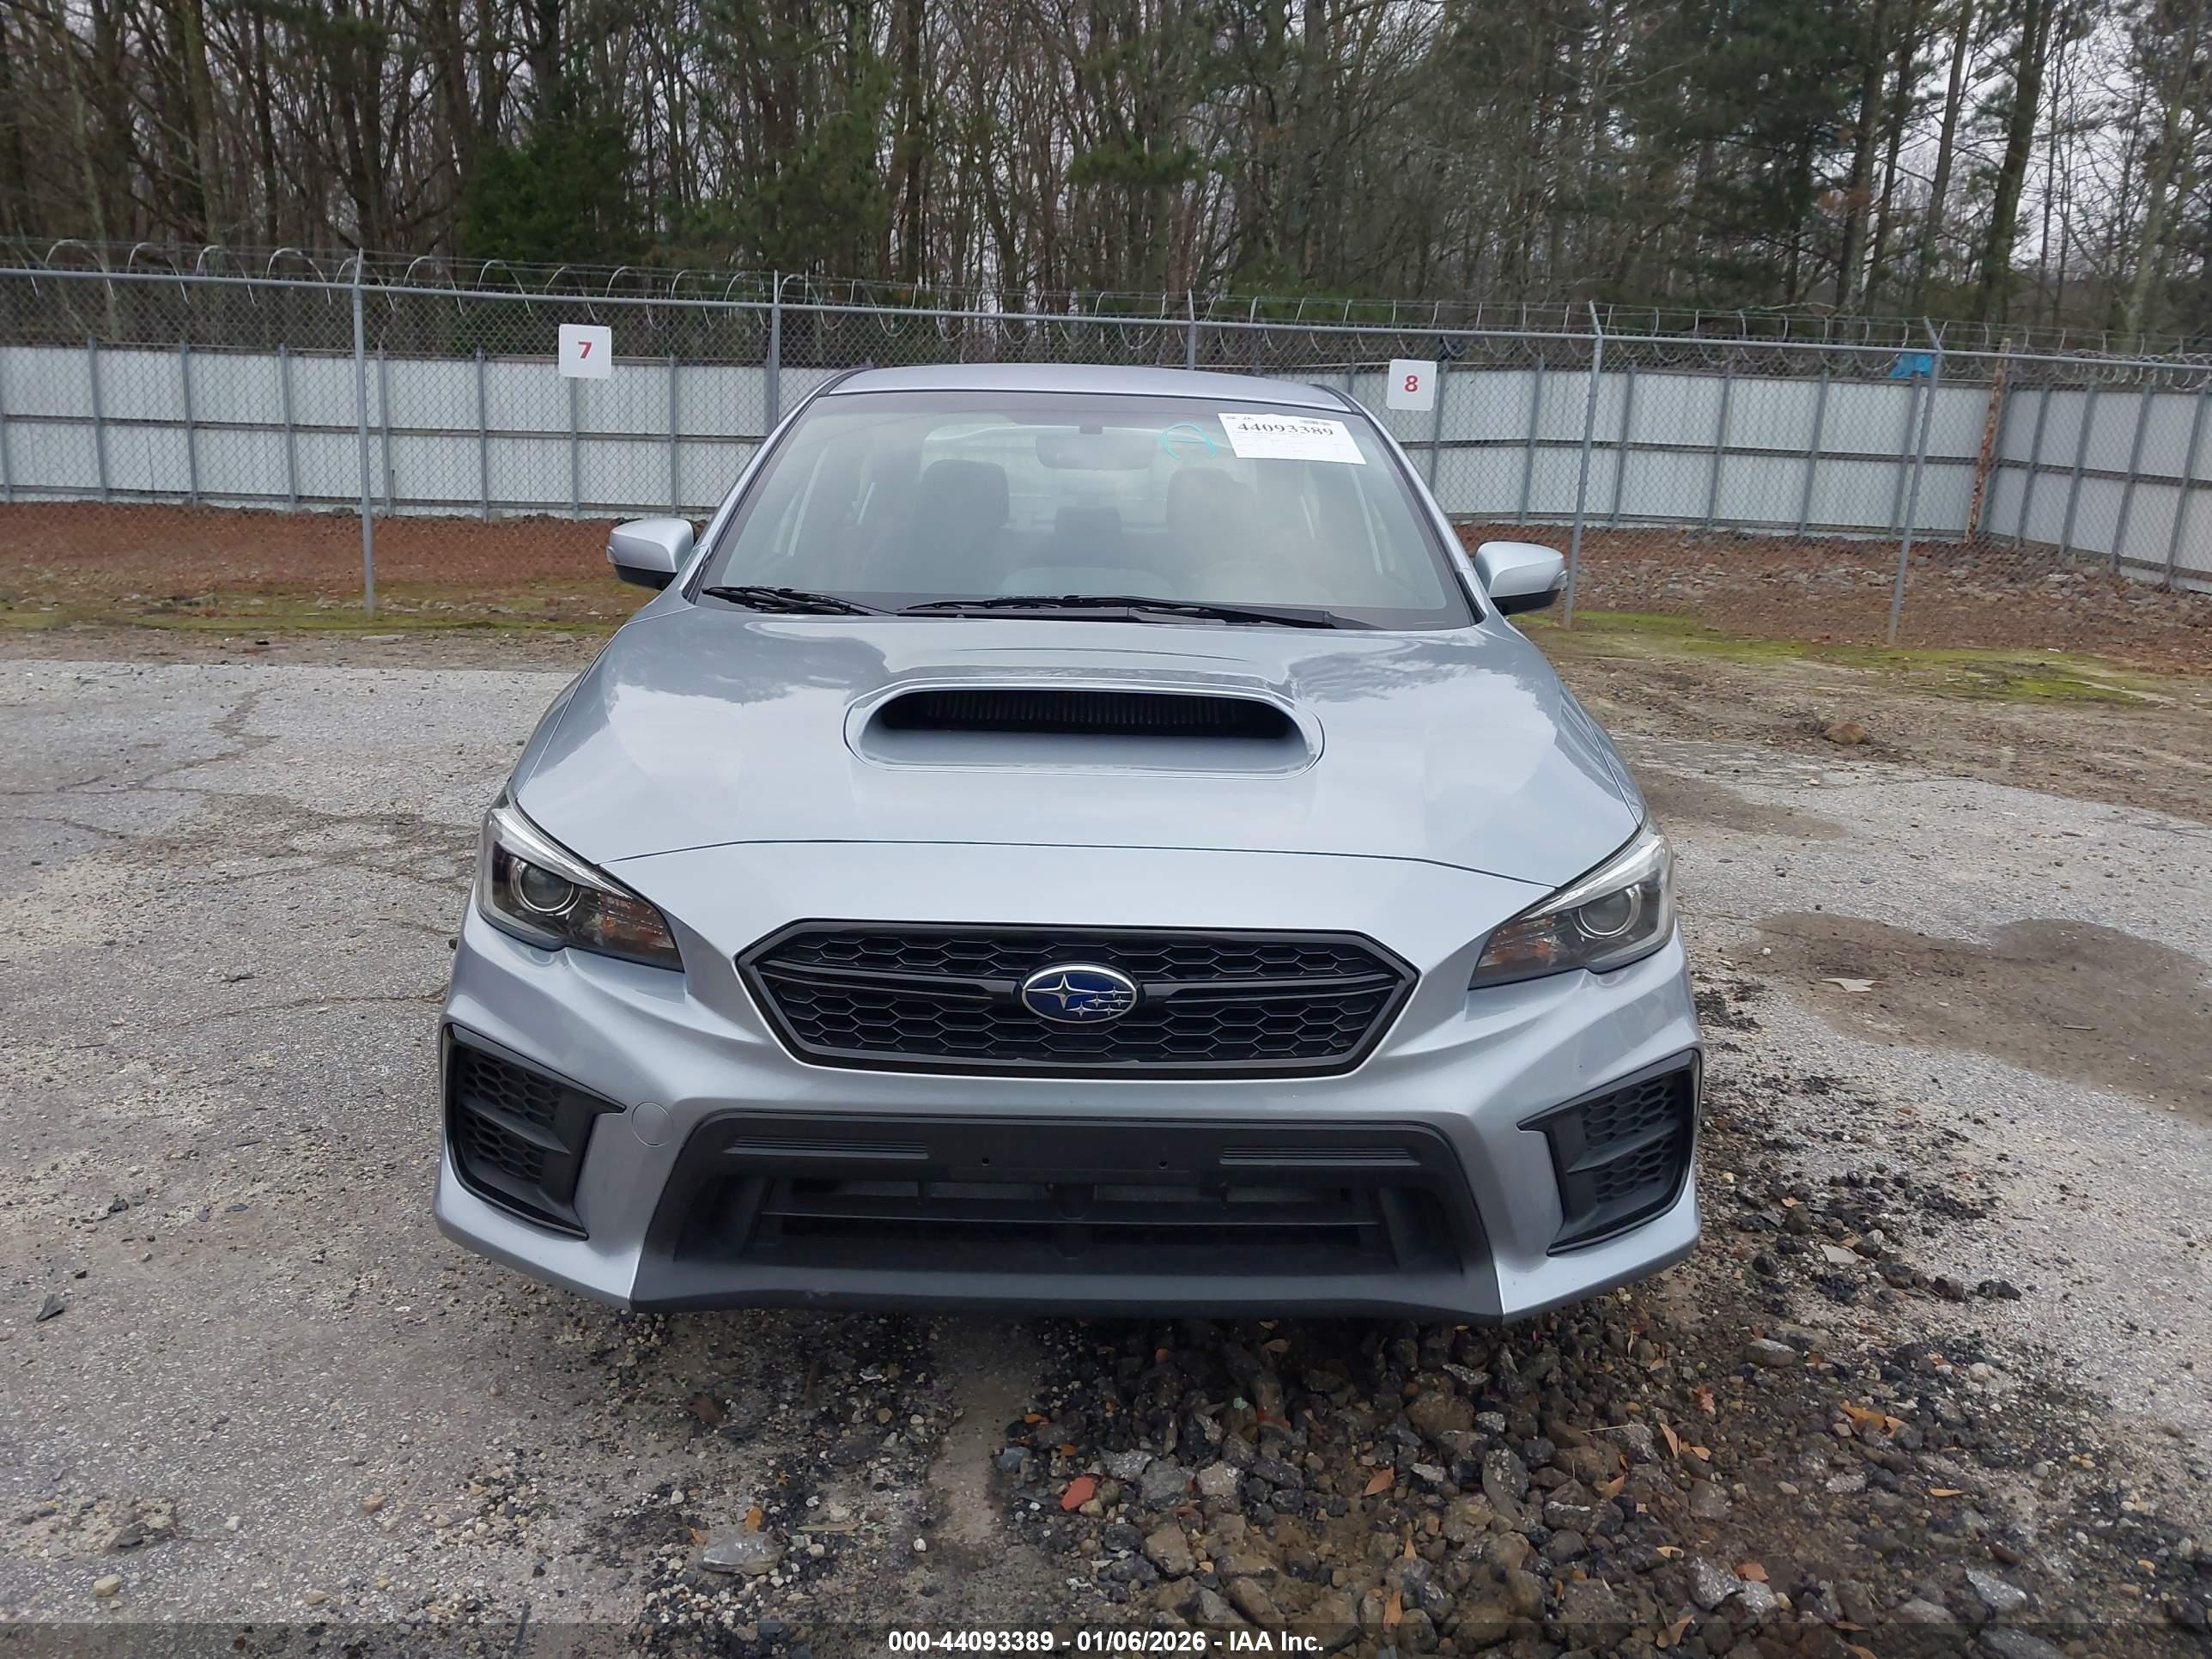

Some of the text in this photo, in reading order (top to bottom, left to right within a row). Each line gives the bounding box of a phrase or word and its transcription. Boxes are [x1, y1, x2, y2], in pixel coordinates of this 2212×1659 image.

[578, 341, 592, 359] 7
[1404, 374, 1419, 392] 8
[1237, 422, 1334, 435] 44093389
